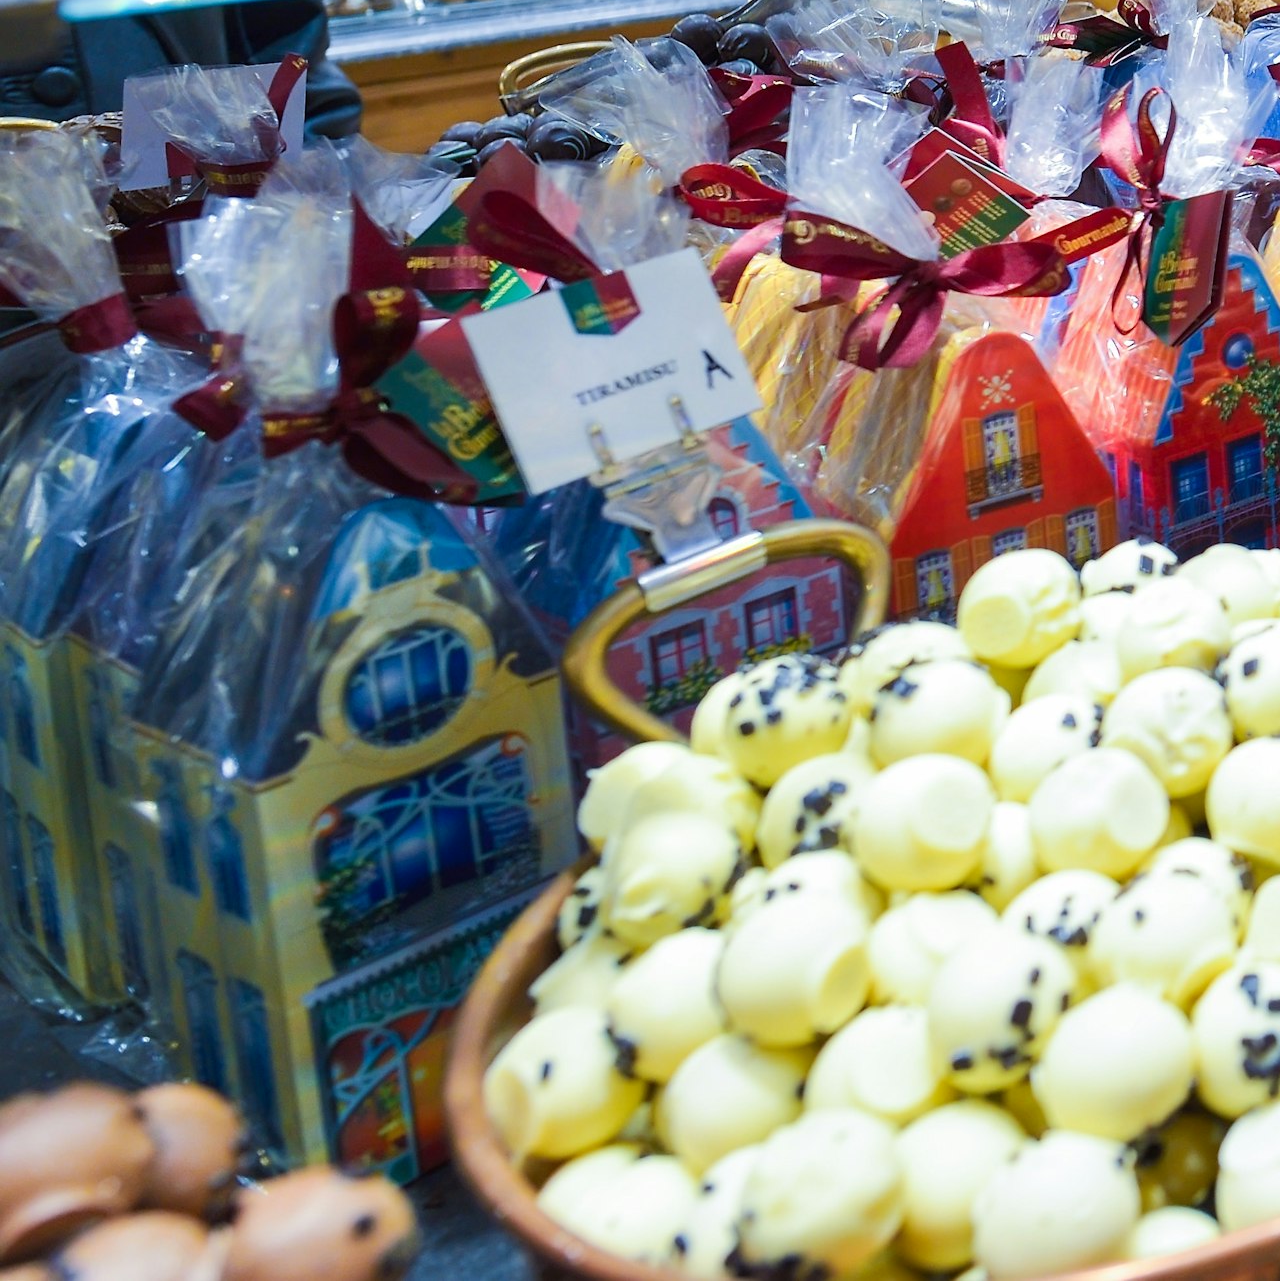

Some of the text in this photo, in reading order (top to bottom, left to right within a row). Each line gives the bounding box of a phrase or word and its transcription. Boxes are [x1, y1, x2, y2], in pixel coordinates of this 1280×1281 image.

[1054, 214, 1131, 256] Gourmande
[574, 359, 679, 407] TIRAMISU
[701, 348, 735, 391] A
